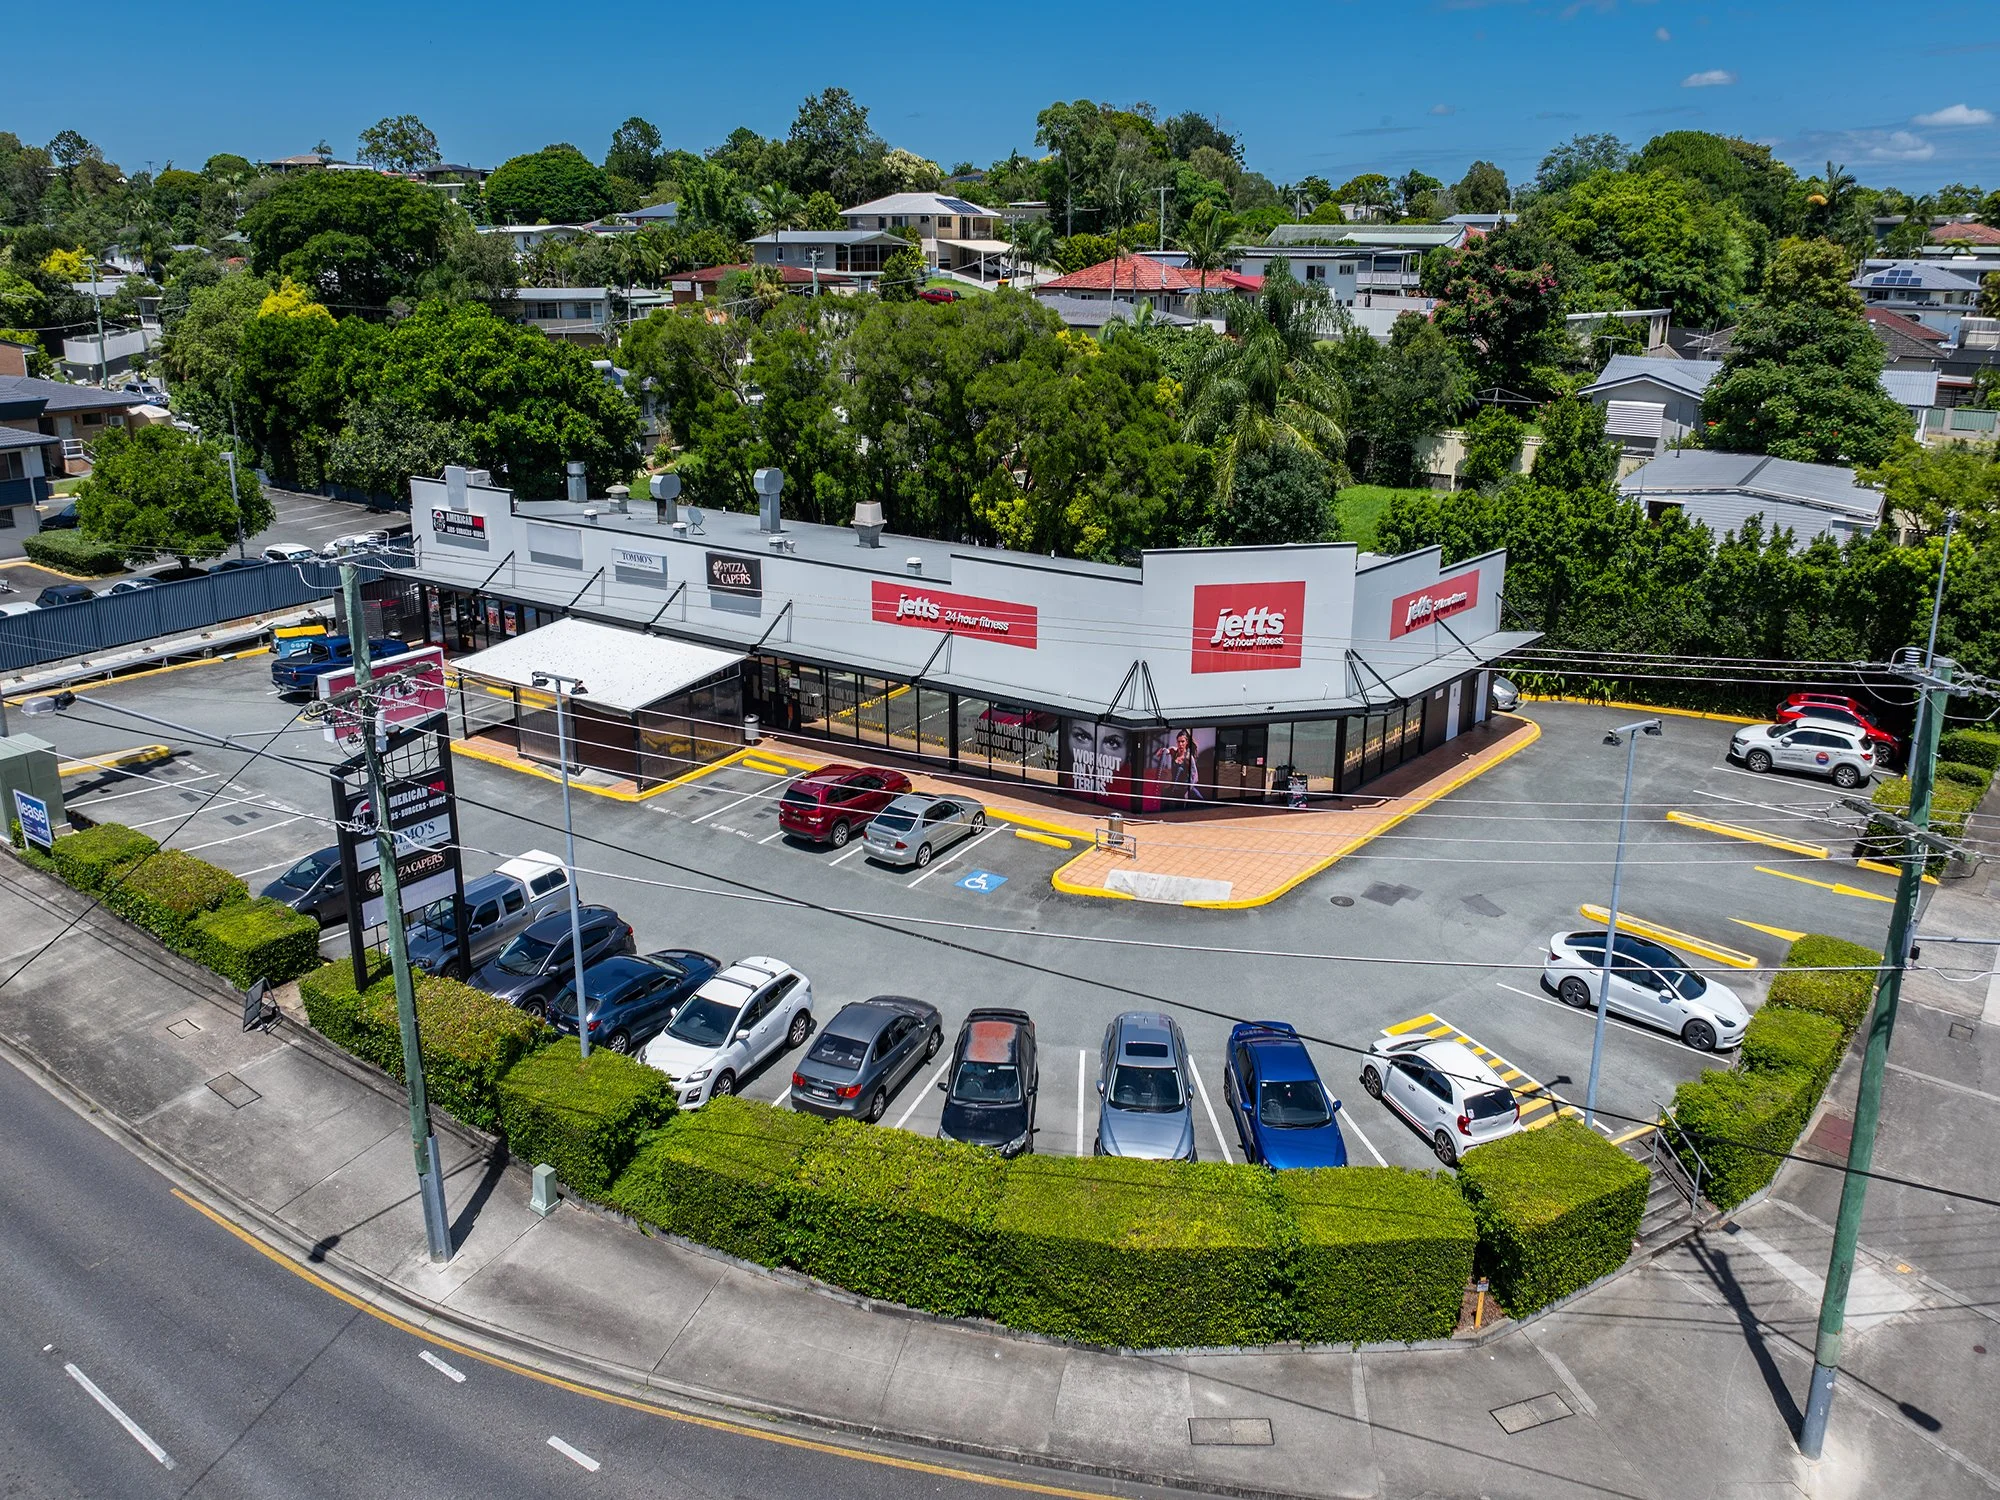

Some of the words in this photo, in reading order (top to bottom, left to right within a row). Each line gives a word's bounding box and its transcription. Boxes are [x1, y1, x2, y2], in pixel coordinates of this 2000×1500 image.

[622, 551, 653, 565] TOMMO'S
[722, 562, 748, 574] PIZZA
[720, 573, 751, 585] CAPERS
[896, 593, 941, 620] jetts
[945, 610, 957, 621] 24
[957, 612, 979, 626] hour
[979, 615, 1010, 631] fitness
[1404, 594, 1433, 627] jetts
[1210, 606, 1286, 644] jetts
[1223, 638, 1235, 648] 24
[1235, 638, 1255, 647] hour
[1256, 636, 1285, 646] fitness
[1073, 748, 1121, 771] WORKOUT
[389, 787, 428, 808] MERICAN
[17, 796, 46, 824] lease
[411, 852, 444, 872] CAPERS
